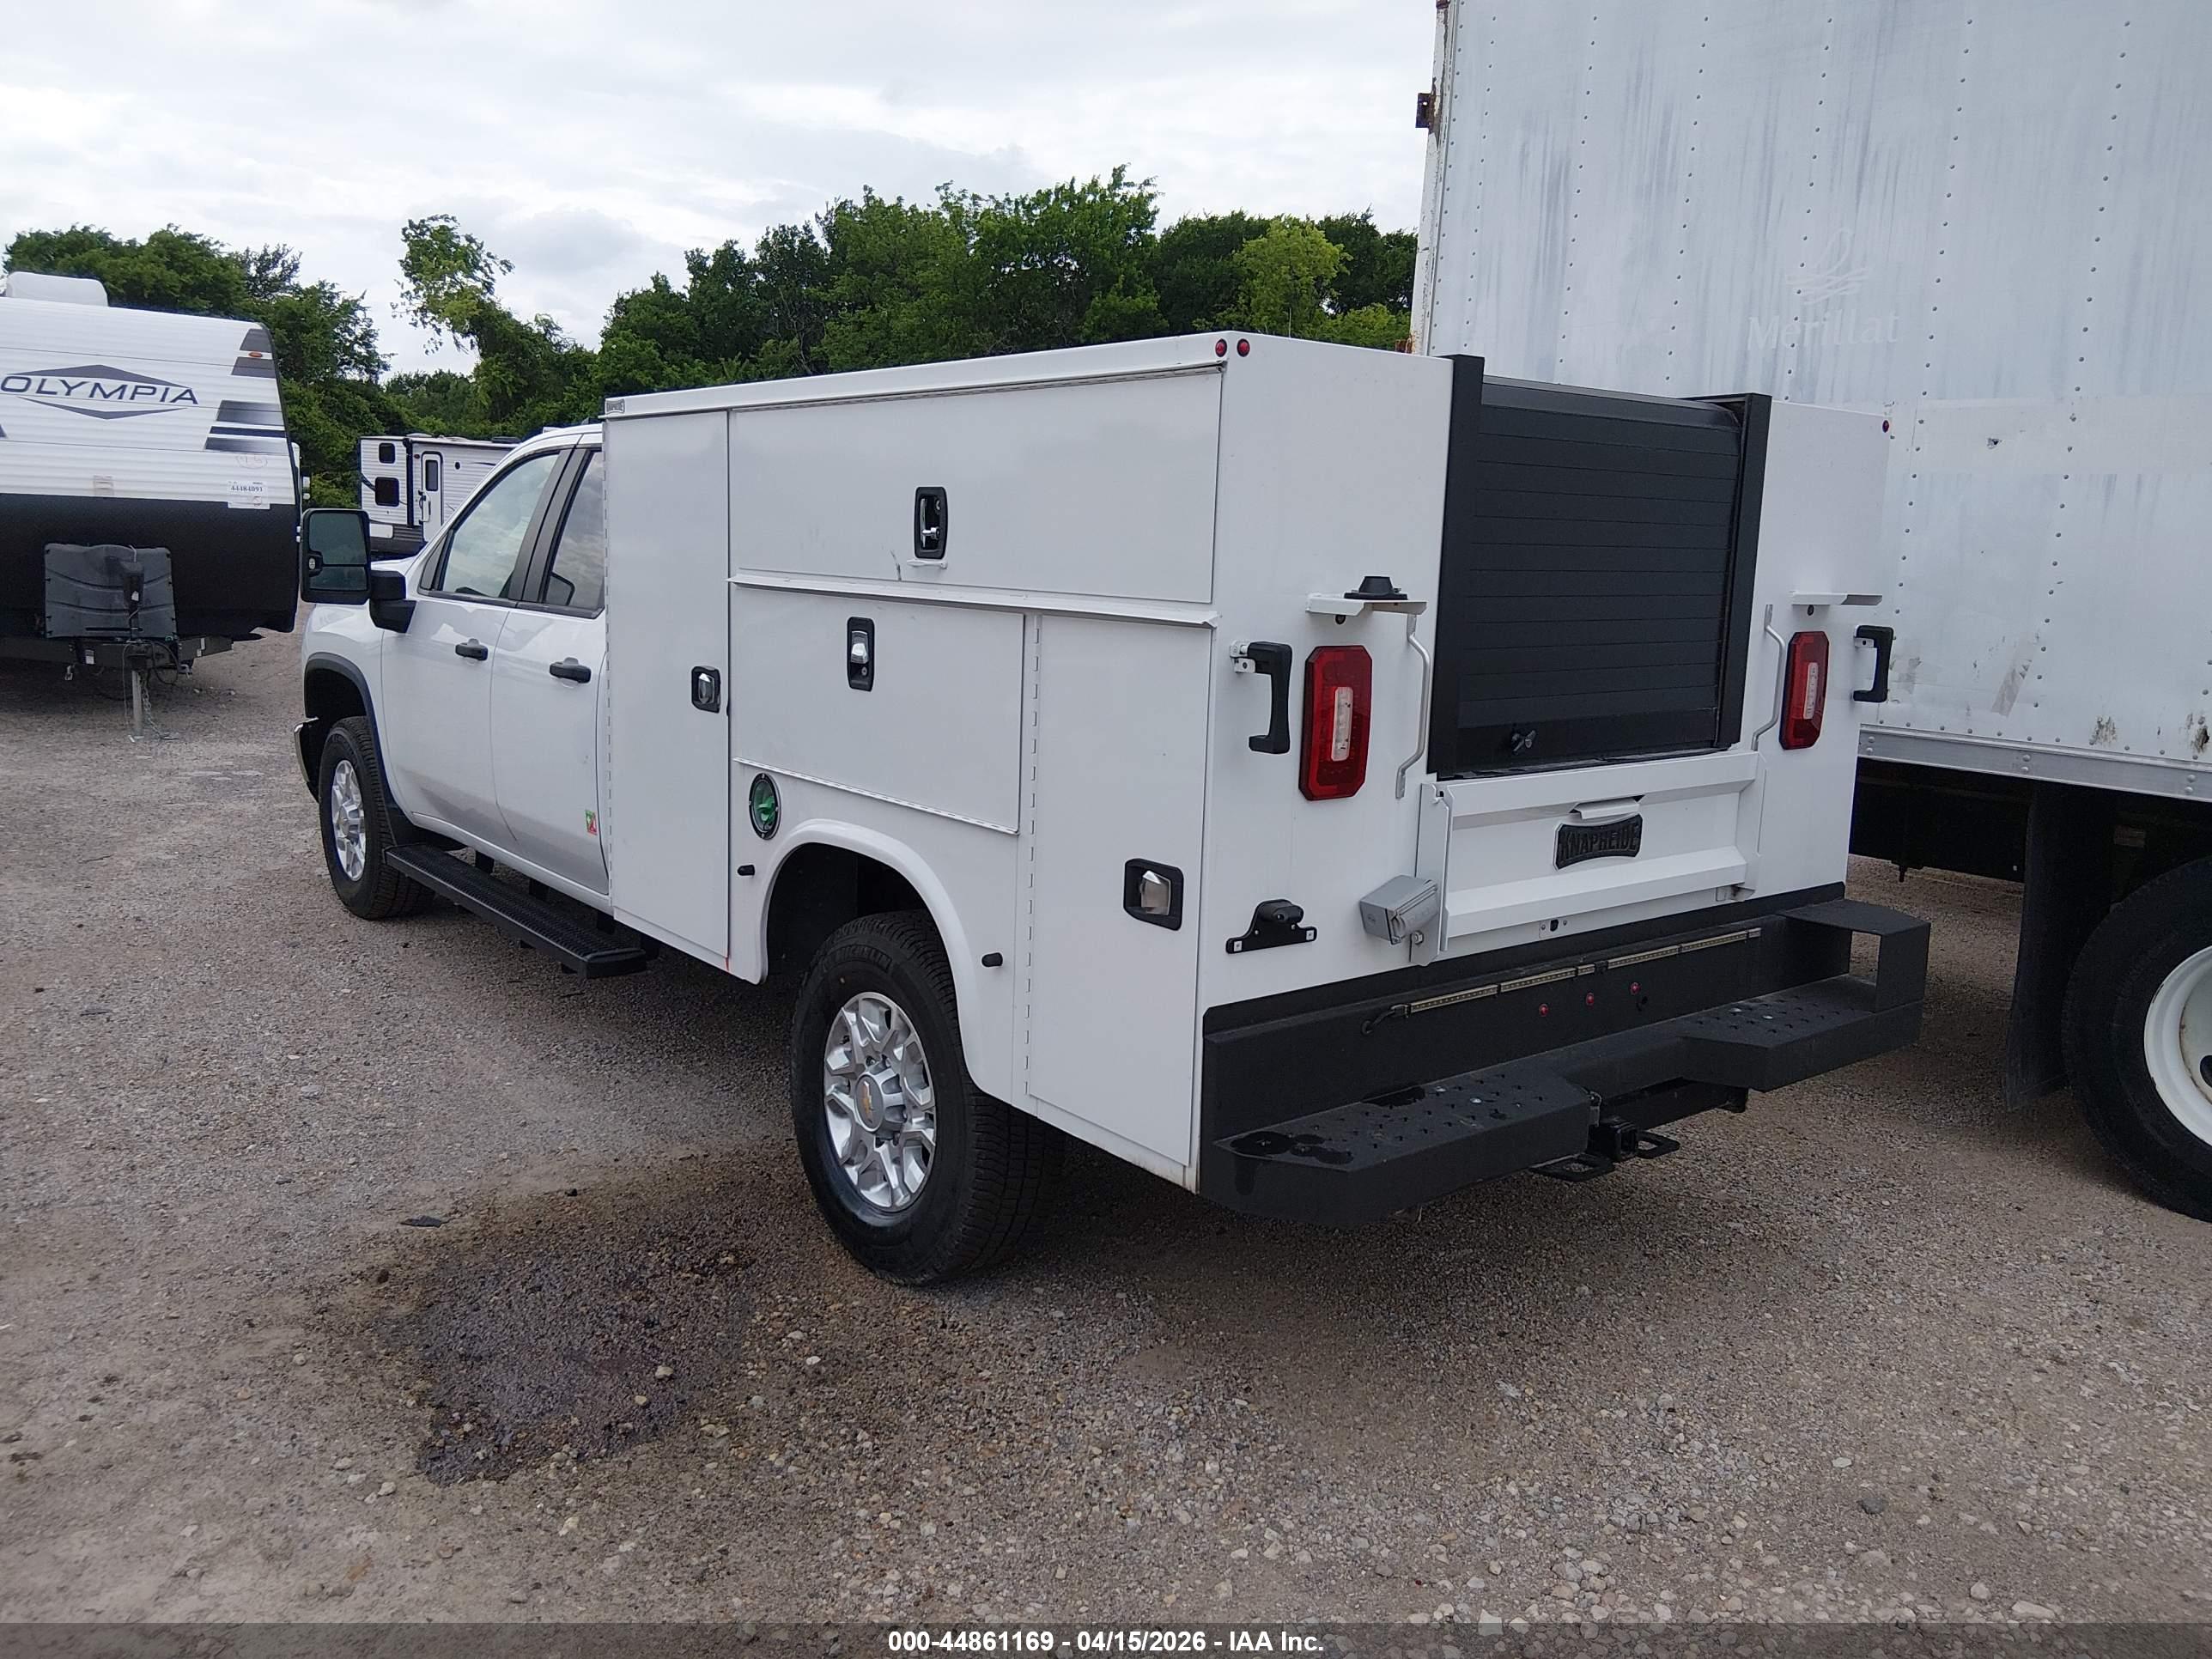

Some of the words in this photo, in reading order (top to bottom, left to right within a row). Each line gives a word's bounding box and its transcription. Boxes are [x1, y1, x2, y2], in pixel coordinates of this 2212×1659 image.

[1747, 308, 1899, 350] Merillat
[0, 375, 199, 405] OLYMPIA
[1559, 821, 1640, 861] KNAPHEIDE
